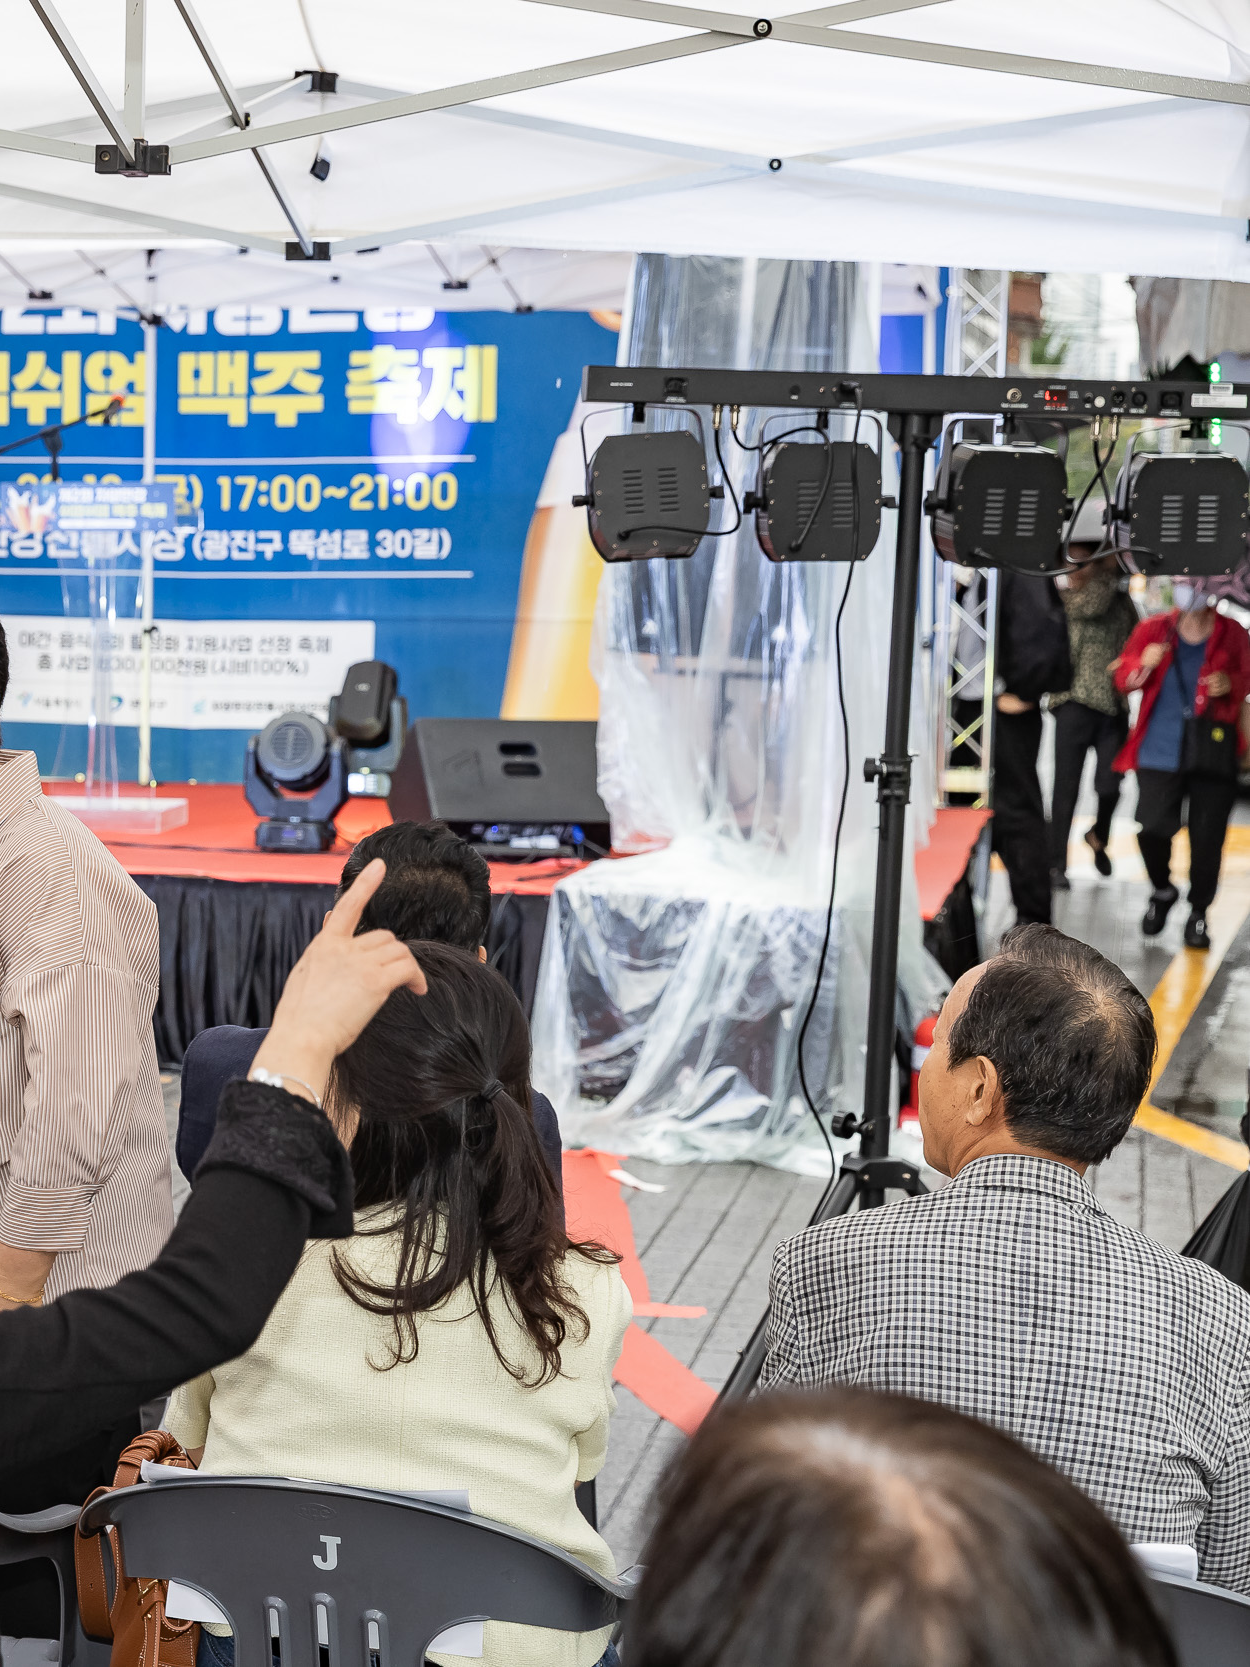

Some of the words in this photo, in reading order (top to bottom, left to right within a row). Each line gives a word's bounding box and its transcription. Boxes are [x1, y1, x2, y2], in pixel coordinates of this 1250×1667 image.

[177, 350, 325, 428] 맥주
[345, 344, 498, 425] 축제
[216, 472, 459, 513] 17:00~21:00
[192, 528, 285, 561] (광진구
[288, 529, 370, 561] 뚝섬로
[375, 528, 452, 561] 30길)
[312, 1534, 342, 1571] J
